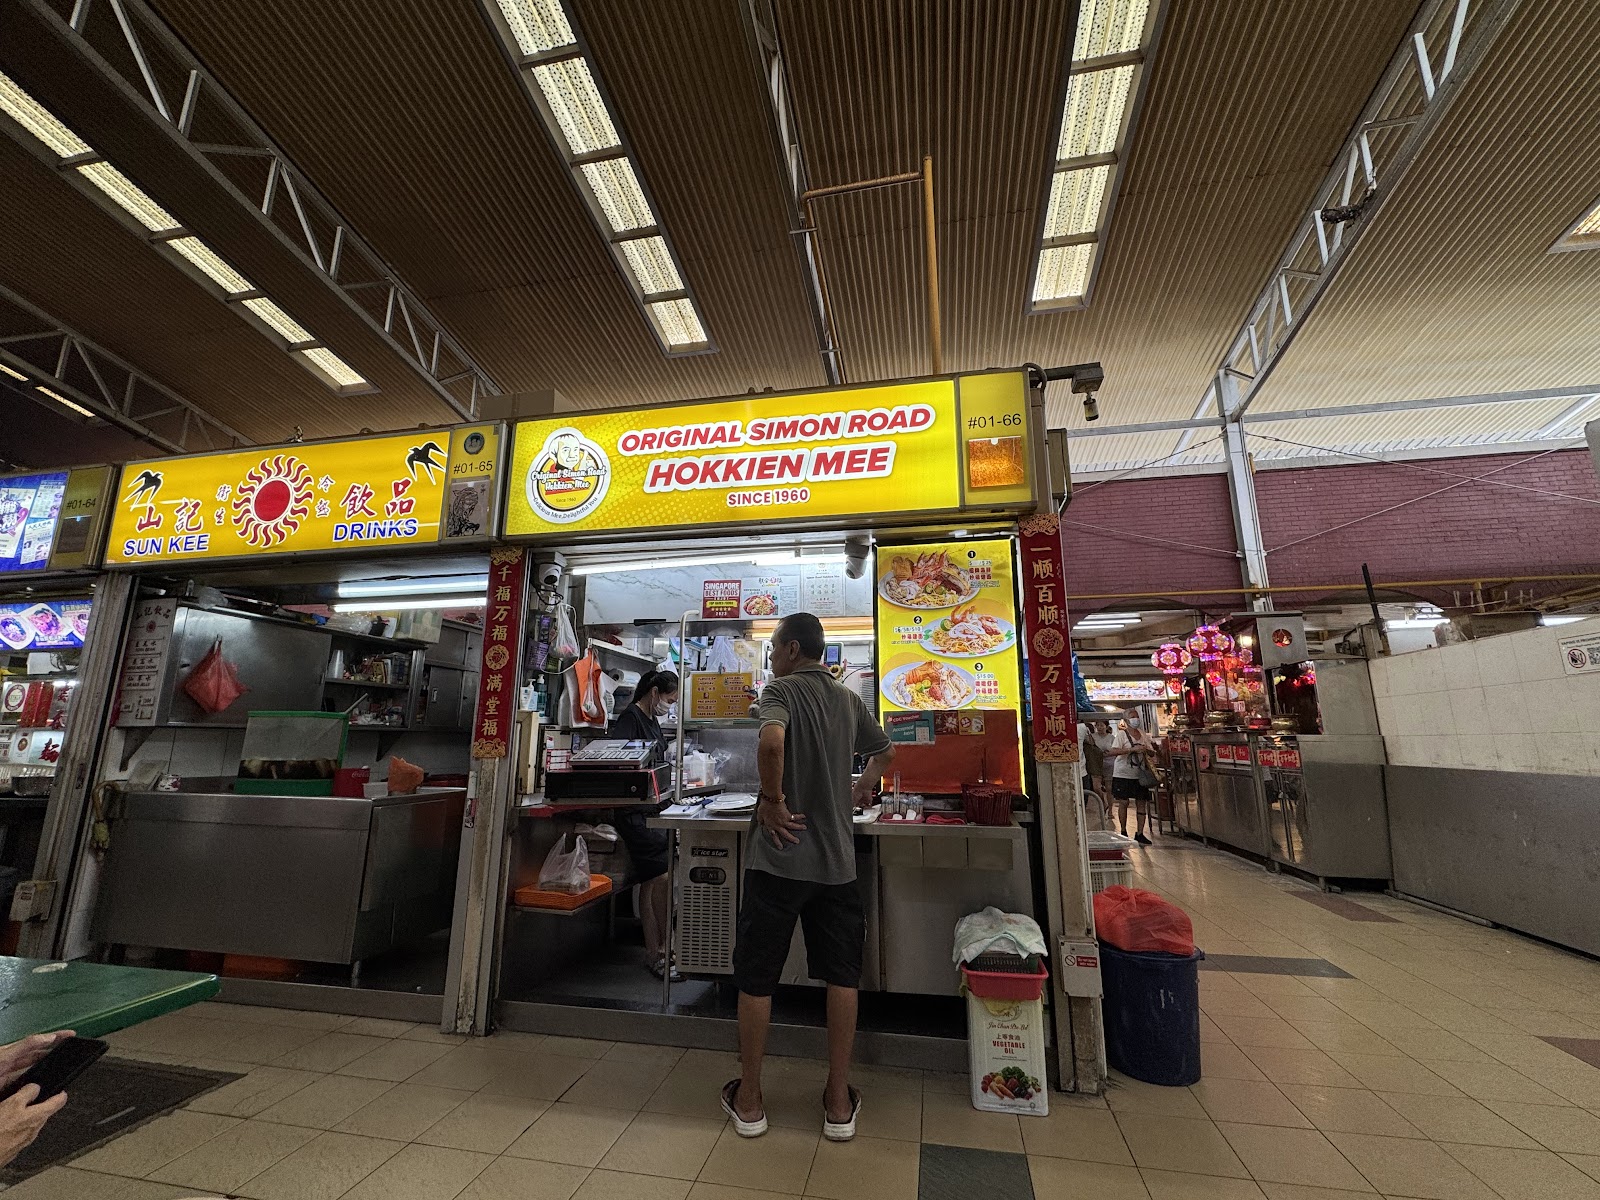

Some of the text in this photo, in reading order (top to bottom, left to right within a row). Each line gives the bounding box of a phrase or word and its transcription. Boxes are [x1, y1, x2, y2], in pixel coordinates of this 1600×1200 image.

[621, 408, 931, 451] ORIGINAL SIMON ROAD
[968, 413, 1022, 429] #01-66
[453, 460, 493, 474] #01-65
[531, 465, 606, 483] Original Simon Road
[649, 446, 890, 488] HOKKIEN MEE
[545, 479, 590, 490] Hokkien Mee
[66, 498, 97, 510] #01-64
[340, 478, 416, 519] 飲品
[728, 488, 809, 505] SINCE 1960
[136, 500, 202, 533] 山記
[333, 518, 419, 542] DRINKS
[124, 534, 210, 556] SUN KEE
[704, 582, 740, 590] SINGAPORE
[992, 1040, 1025, 1049] VEGETABLE
